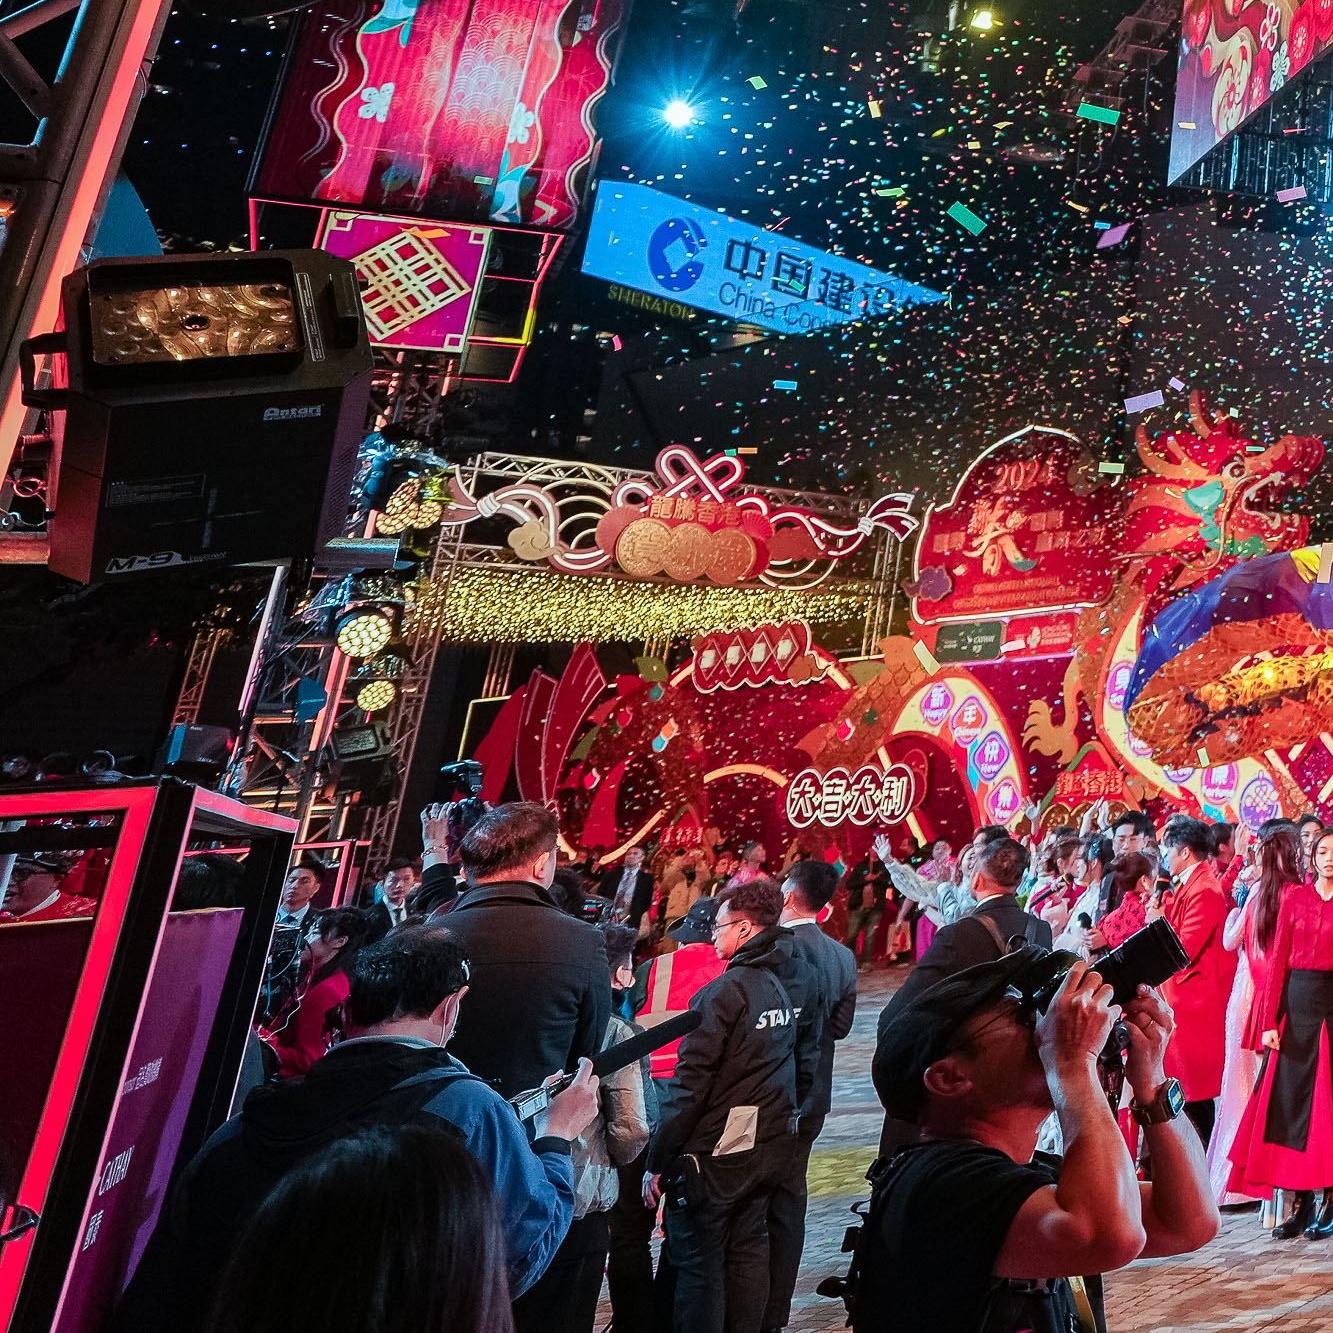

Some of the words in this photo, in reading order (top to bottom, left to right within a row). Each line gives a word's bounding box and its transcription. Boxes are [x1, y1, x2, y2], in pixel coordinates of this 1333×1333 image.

[719, 281, 775, 321] China
[648, 494, 742, 527] 龍騰香港
